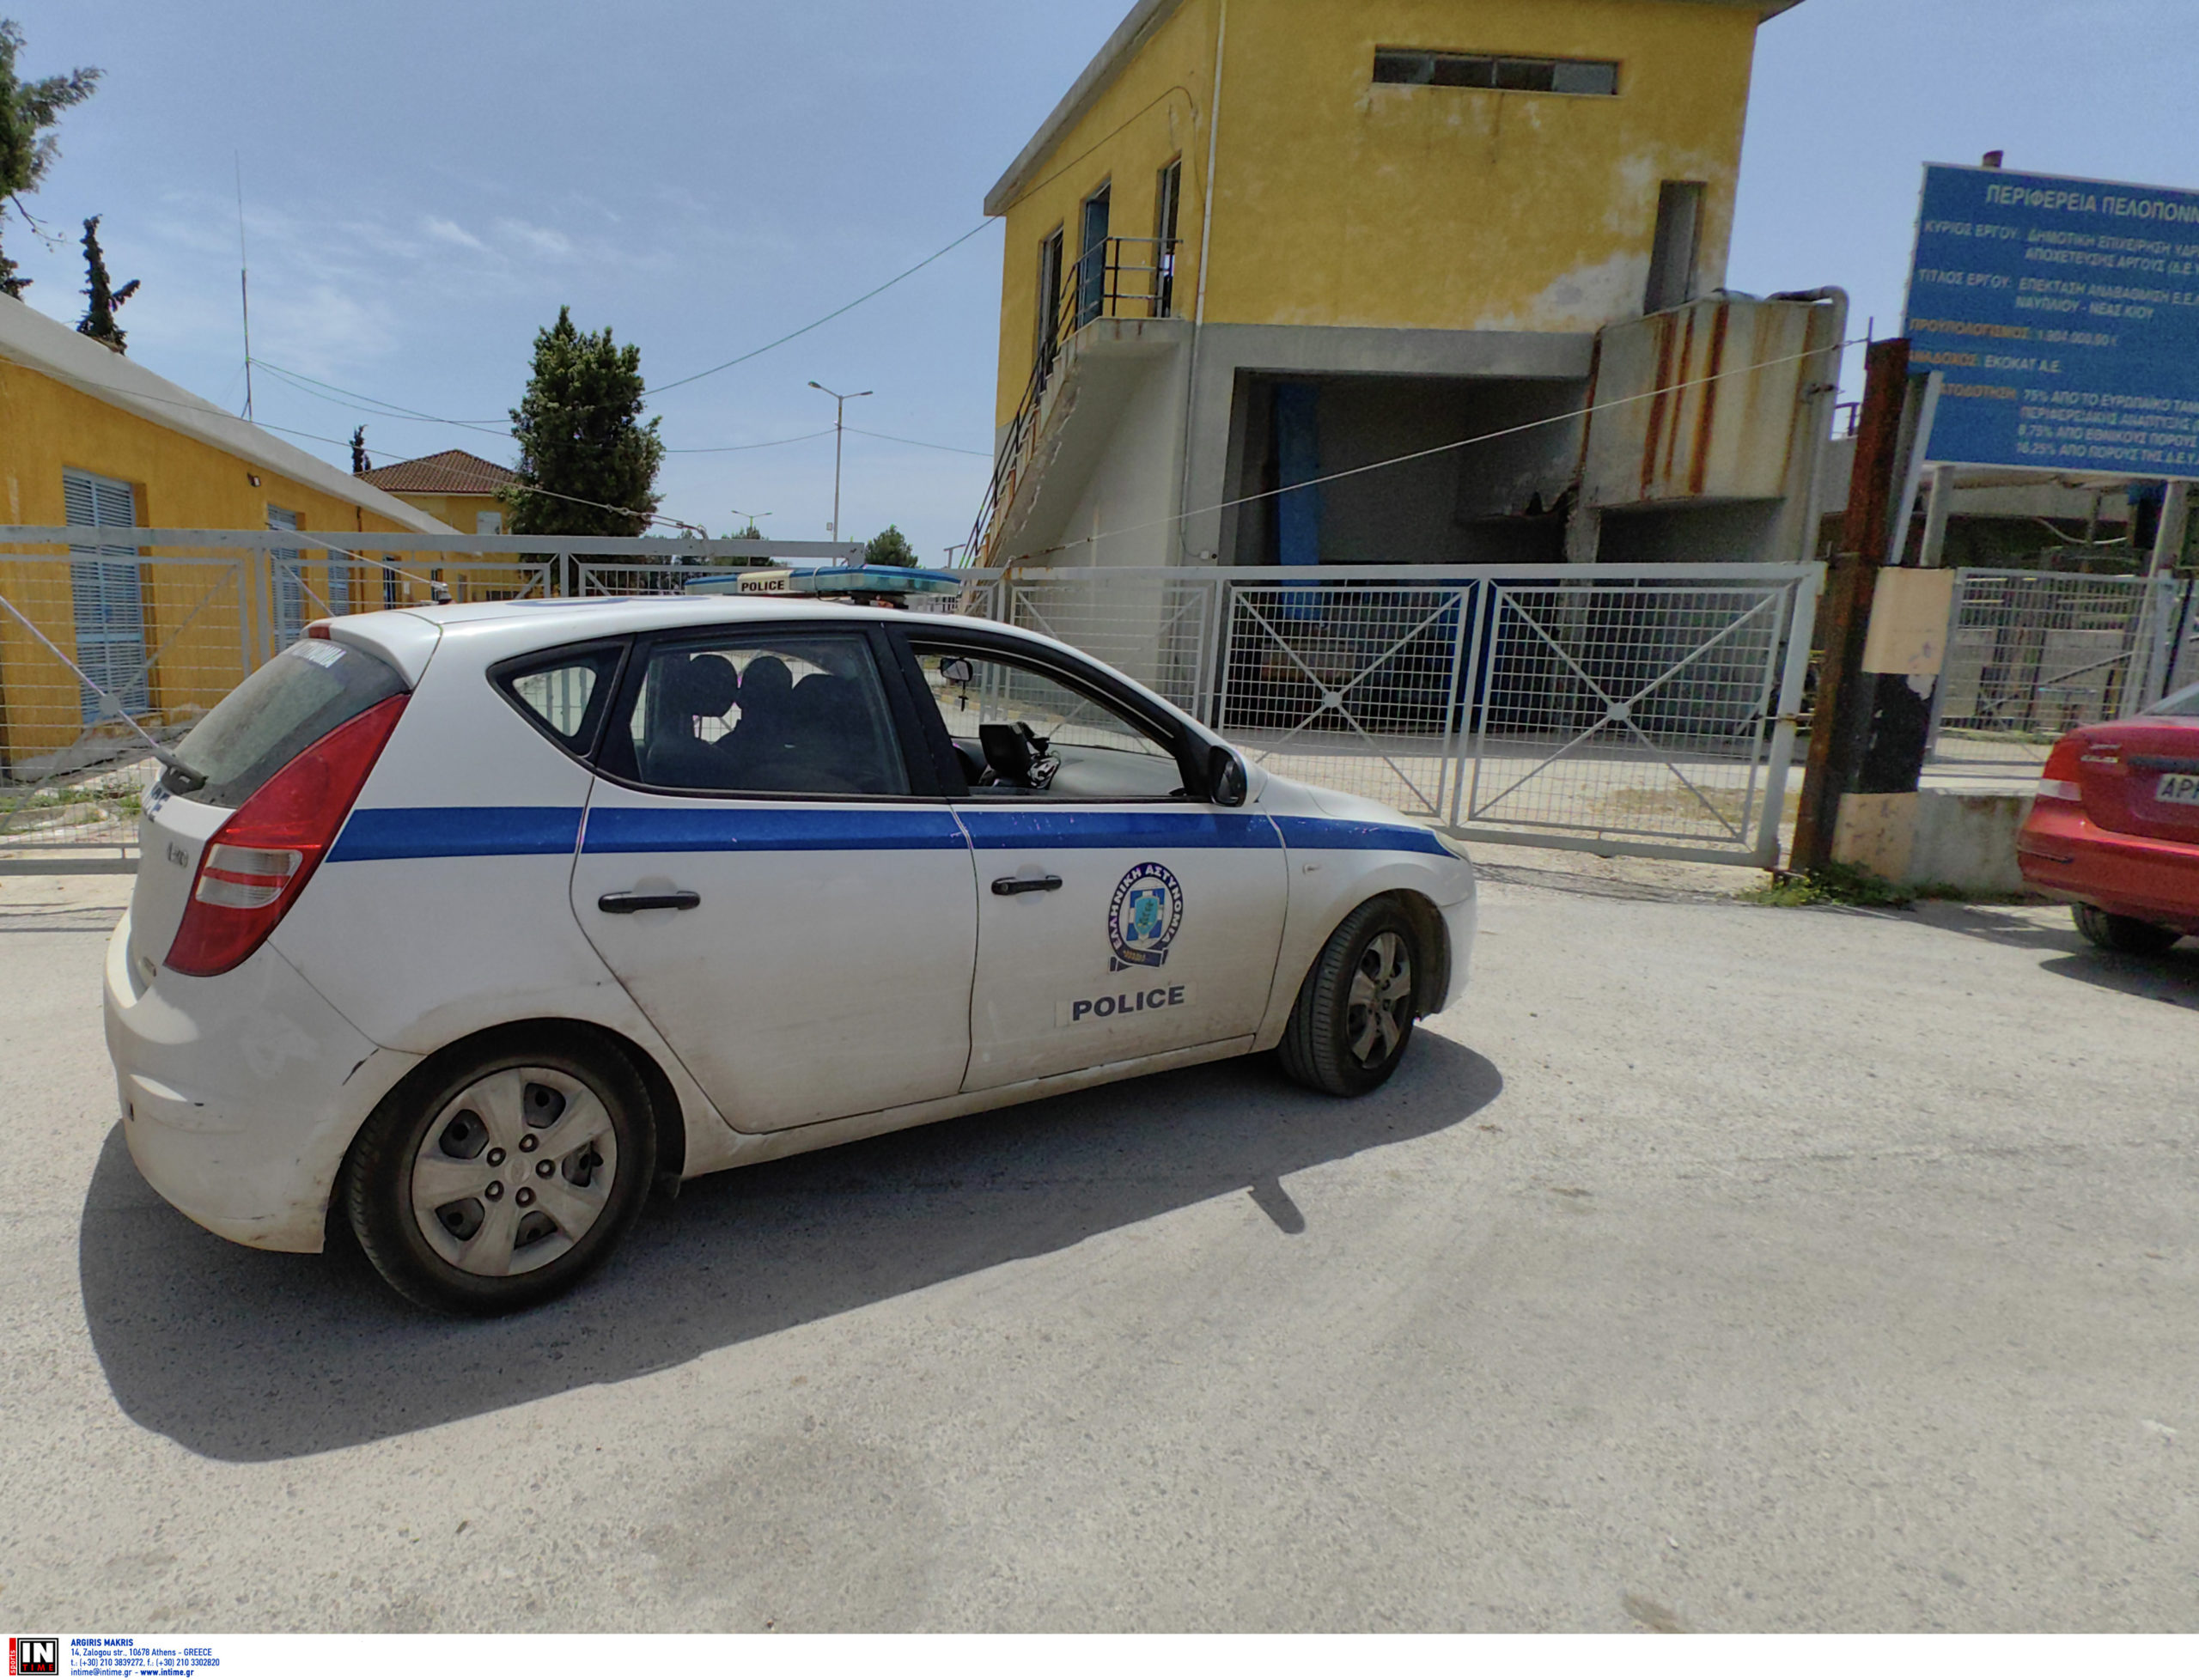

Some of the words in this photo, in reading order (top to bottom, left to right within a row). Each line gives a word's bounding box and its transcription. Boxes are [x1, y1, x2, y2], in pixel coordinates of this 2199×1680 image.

[1985, 184, 2097, 212] ΠΕΡΙΦΕΡΕΙΑ
[1924, 221, 1972, 236] ΚΥΡΙΟΣ
[2027, 228, 2095, 247] ΔΗΜΟΤΙΚΗ
[1918, 269, 1964, 285] ΤΙΤΛΟΣ
[2019, 277, 2086, 295] ΕΠΕΚΤΑΣΗ
[1984, 355, 2037, 370] ΕΚΟΚΑΤ
[2050, 391, 2080, 406] ΑΠΟ
[2081, 393, 2099, 406] ΤΟ
[2056, 426, 2084, 441] ΑΠΟ
[2058, 443, 2087, 458] ΑΠΟ
[741, 580, 785, 592] POLICE
[1109, 867, 1142, 950] ΕΛΛΗΝΙΚΗ
[1145, 864, 1182, 943] ΑΣΤΥΝΟΜΙΑ
[1072, 985, 1185, 1021] POLICE
